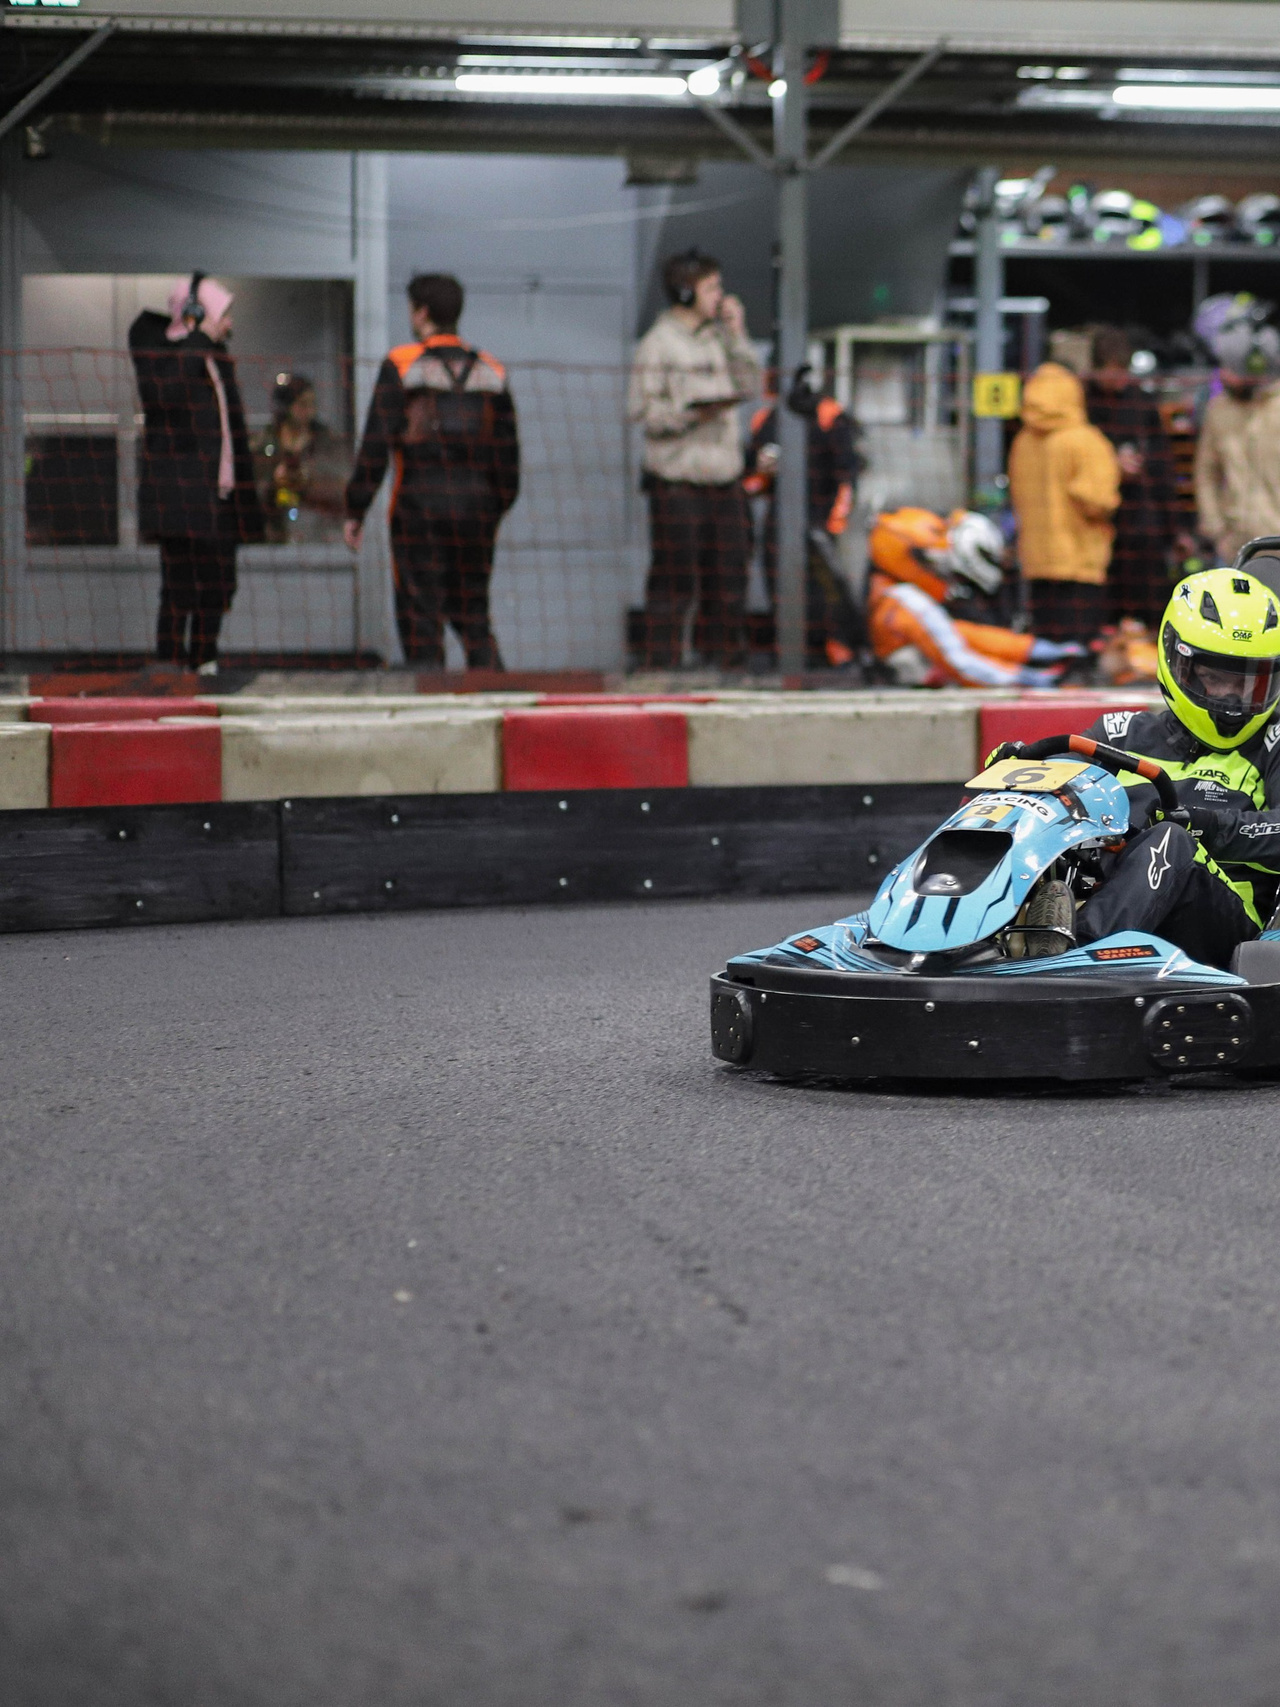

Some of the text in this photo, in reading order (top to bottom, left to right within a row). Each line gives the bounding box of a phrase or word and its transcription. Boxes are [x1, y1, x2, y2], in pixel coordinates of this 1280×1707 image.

[1001, 766, 1052, 785] 6
[974, 805, 998, 815] 8
[978, 796, 1049, 817] RACING
